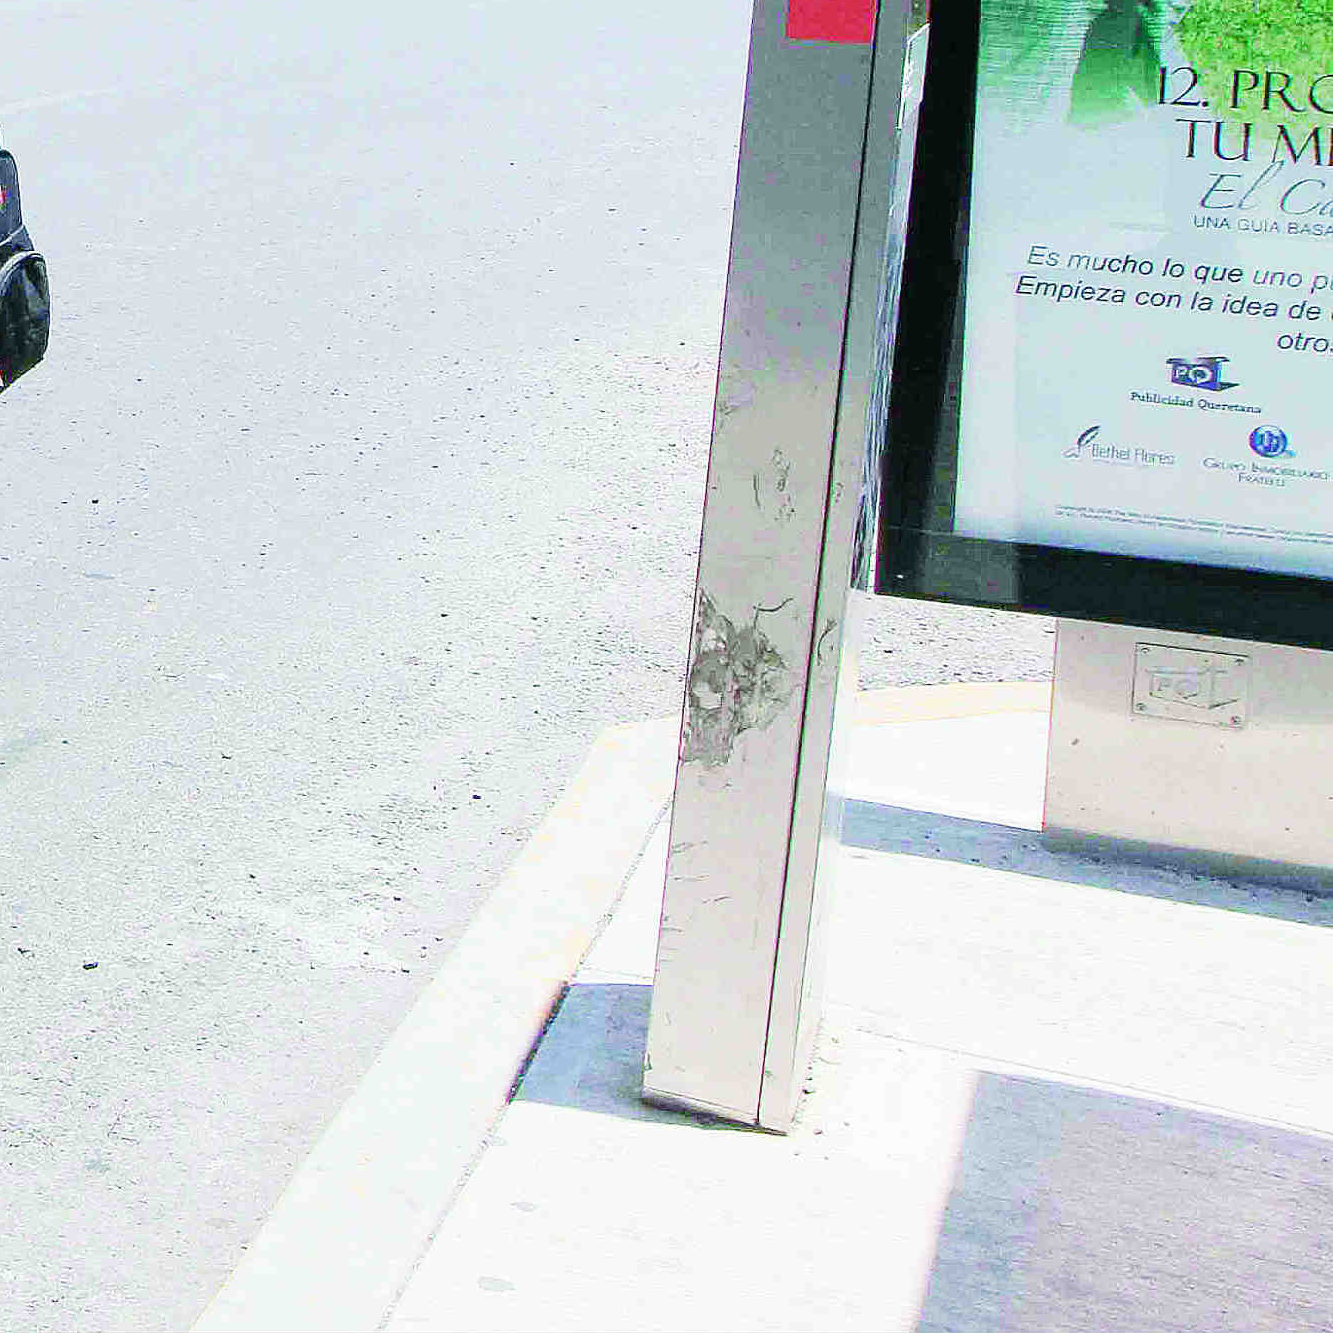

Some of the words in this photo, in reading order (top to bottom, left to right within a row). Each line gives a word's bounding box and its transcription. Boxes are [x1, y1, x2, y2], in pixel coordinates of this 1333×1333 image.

[1158, 66, 1209, 107] 12.
[1175, 117, 1253, 162] TU
[1192, 215, 1231, 230] UNA
[1027, 245, 1060, 267] Es
[1066, 250, 1153, 276] mucho
[1162, 258, 1184, 278] lo
[1194, 263, 1243, 284] que
[1252, 268, 1303, 288] uno
[1014, 274, 1126, 304] Empieza
[1134, 289, 1181, 309] con
[1190, 291, 1213, 312] la
[1221, 293, 1278, 318] idea
[1288, 300, 1321, 321] de
[1277, 333, 1333, 353] otro
[1130, 391, 1194, 409] Publicidad
